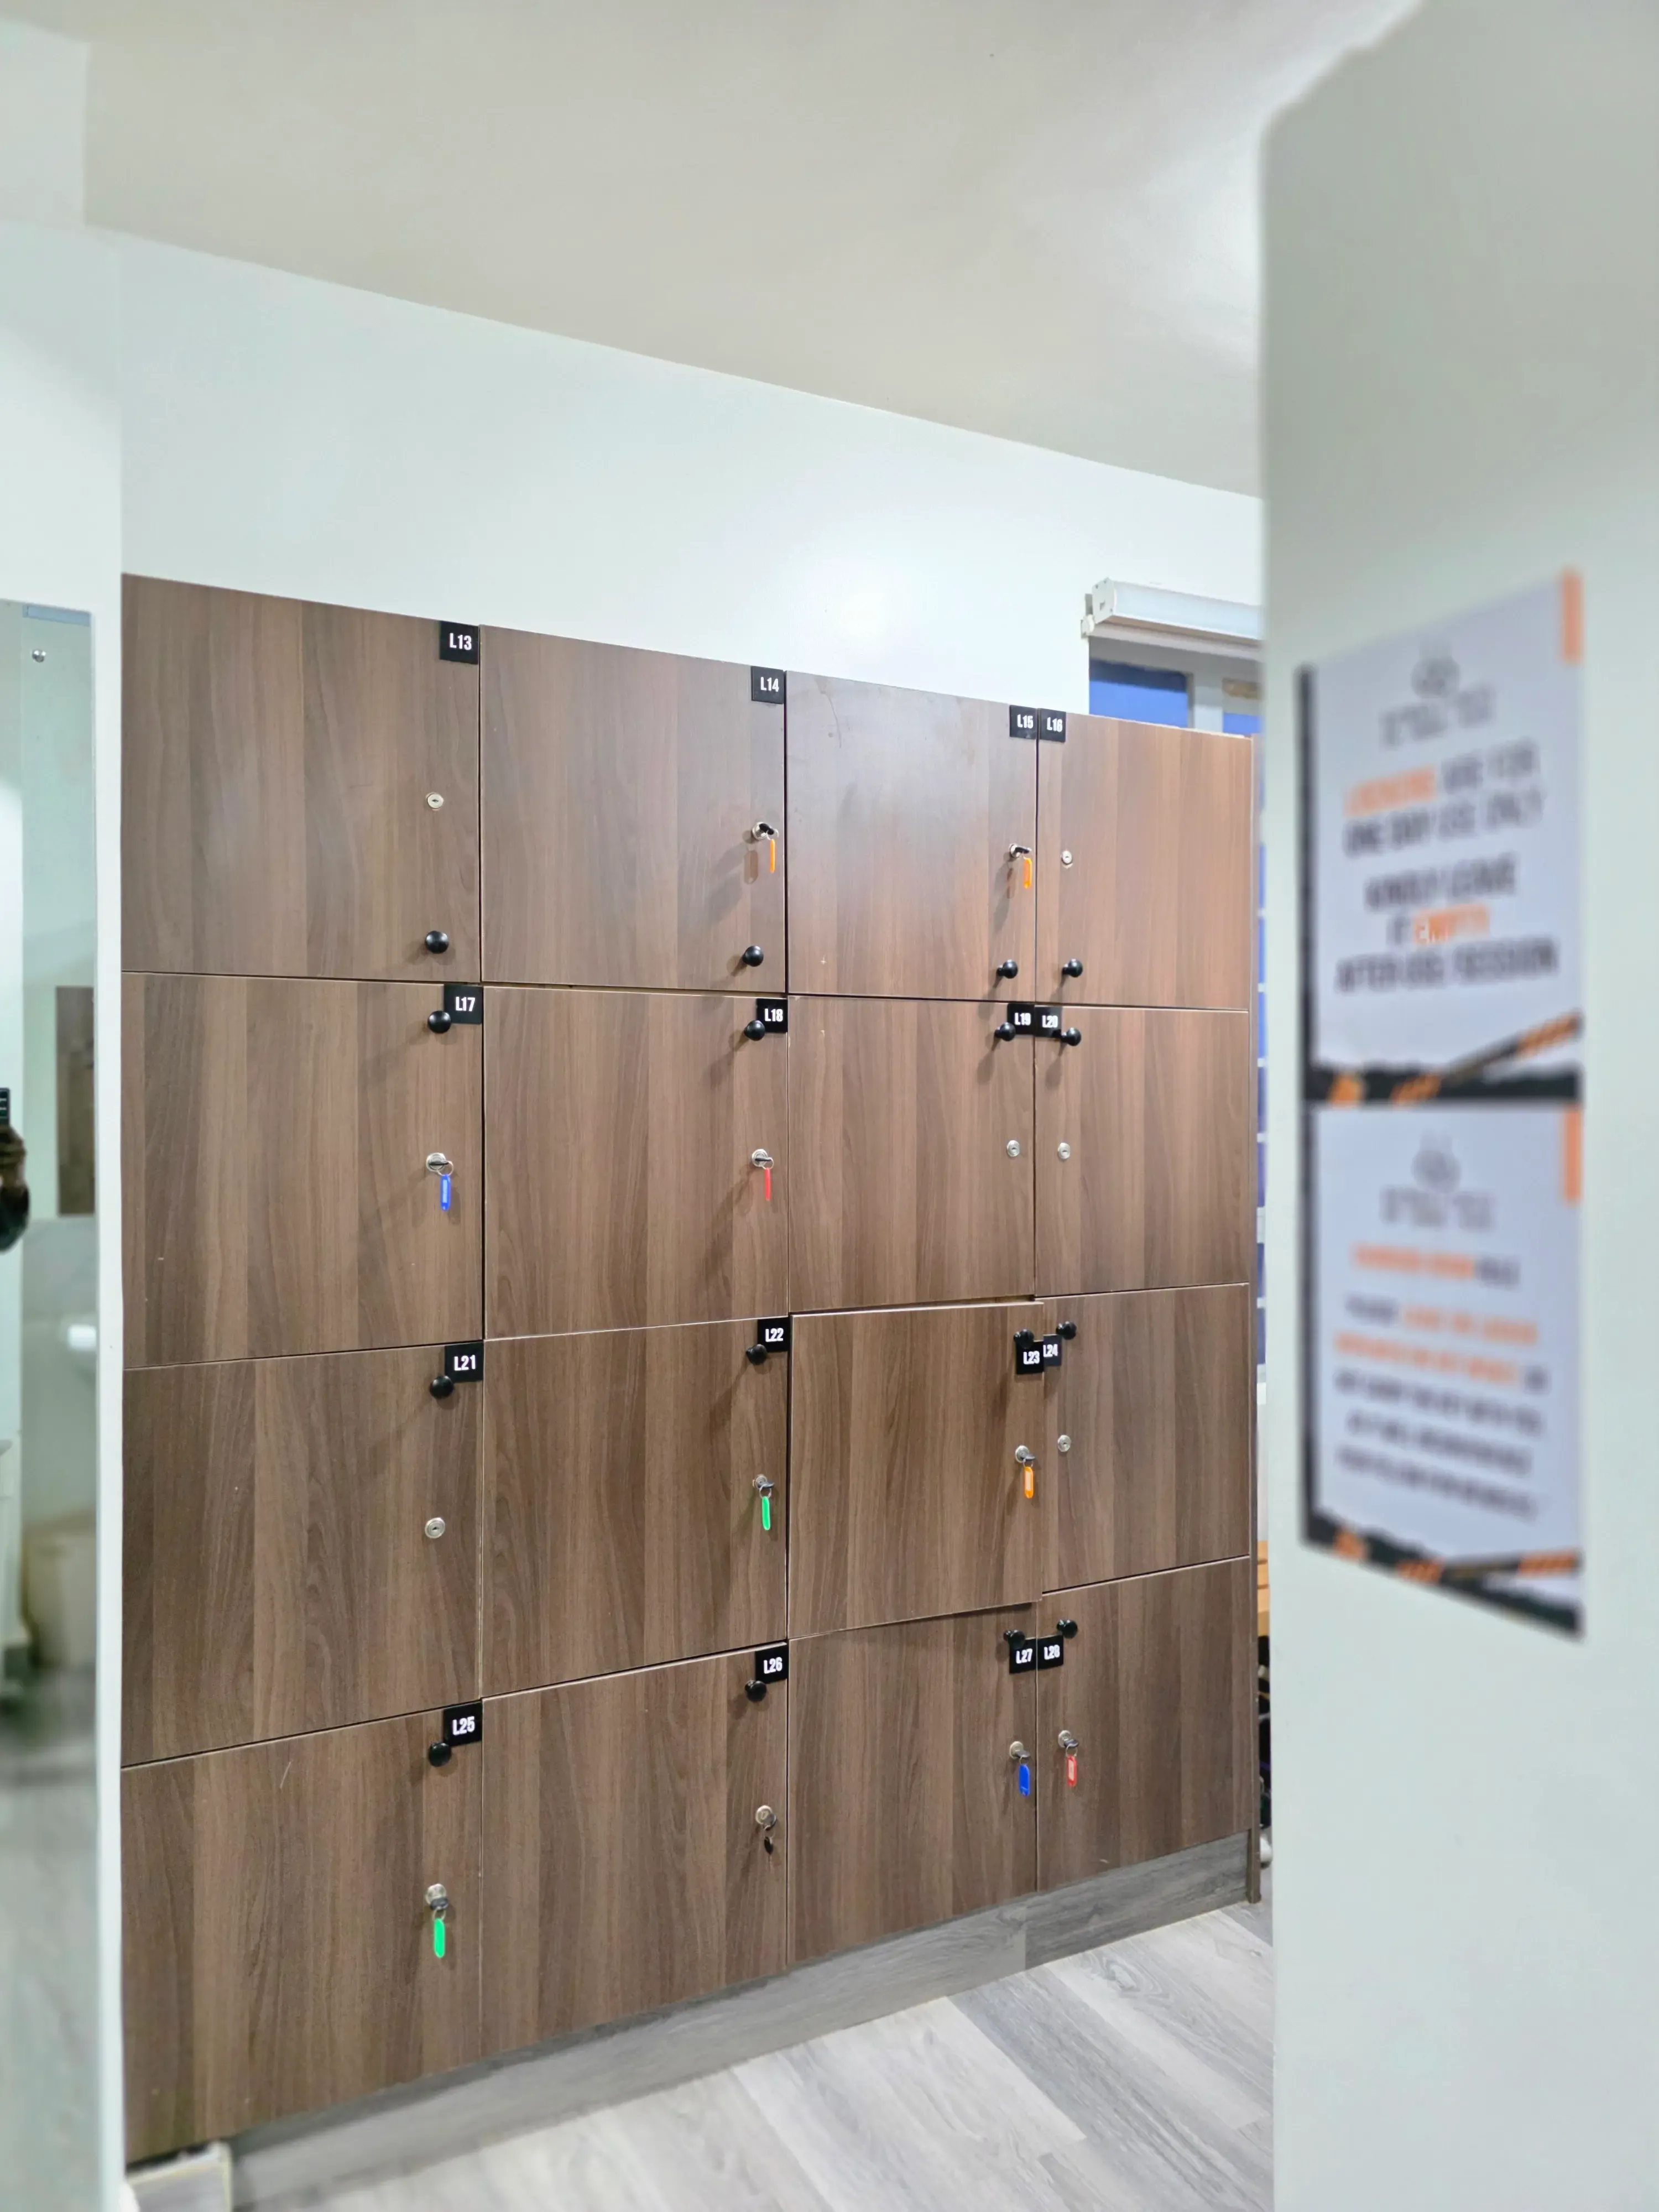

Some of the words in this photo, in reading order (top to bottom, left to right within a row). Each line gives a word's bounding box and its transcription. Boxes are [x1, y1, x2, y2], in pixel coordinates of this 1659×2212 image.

[450, 633, 472, 650] L13
[760, 677, 779, 692] L14
[1017, 714, 1034, 729] L15
[1047, 717, 1063, 732] L16
[456, 997, 476, 1011] L17
[765, 1009, 783, 1022] L18
[1015, 1012, 1031, 1025] L19
[1042, 1015, 1058, 1027] L20
[765, 1328, 784, 1342] L22
[1023, 1351, 1040, 1365] L23
[1044, 1344, 1058, 1358] L24
[454, 1355, 476, 1371] L21
[1016, 1648, 1032, 1663] L27
[1044, 1645, 1060, 1660] L28
[763, 1660, 782, 1674] L26
[452, 1717, 474, 1735] L25
